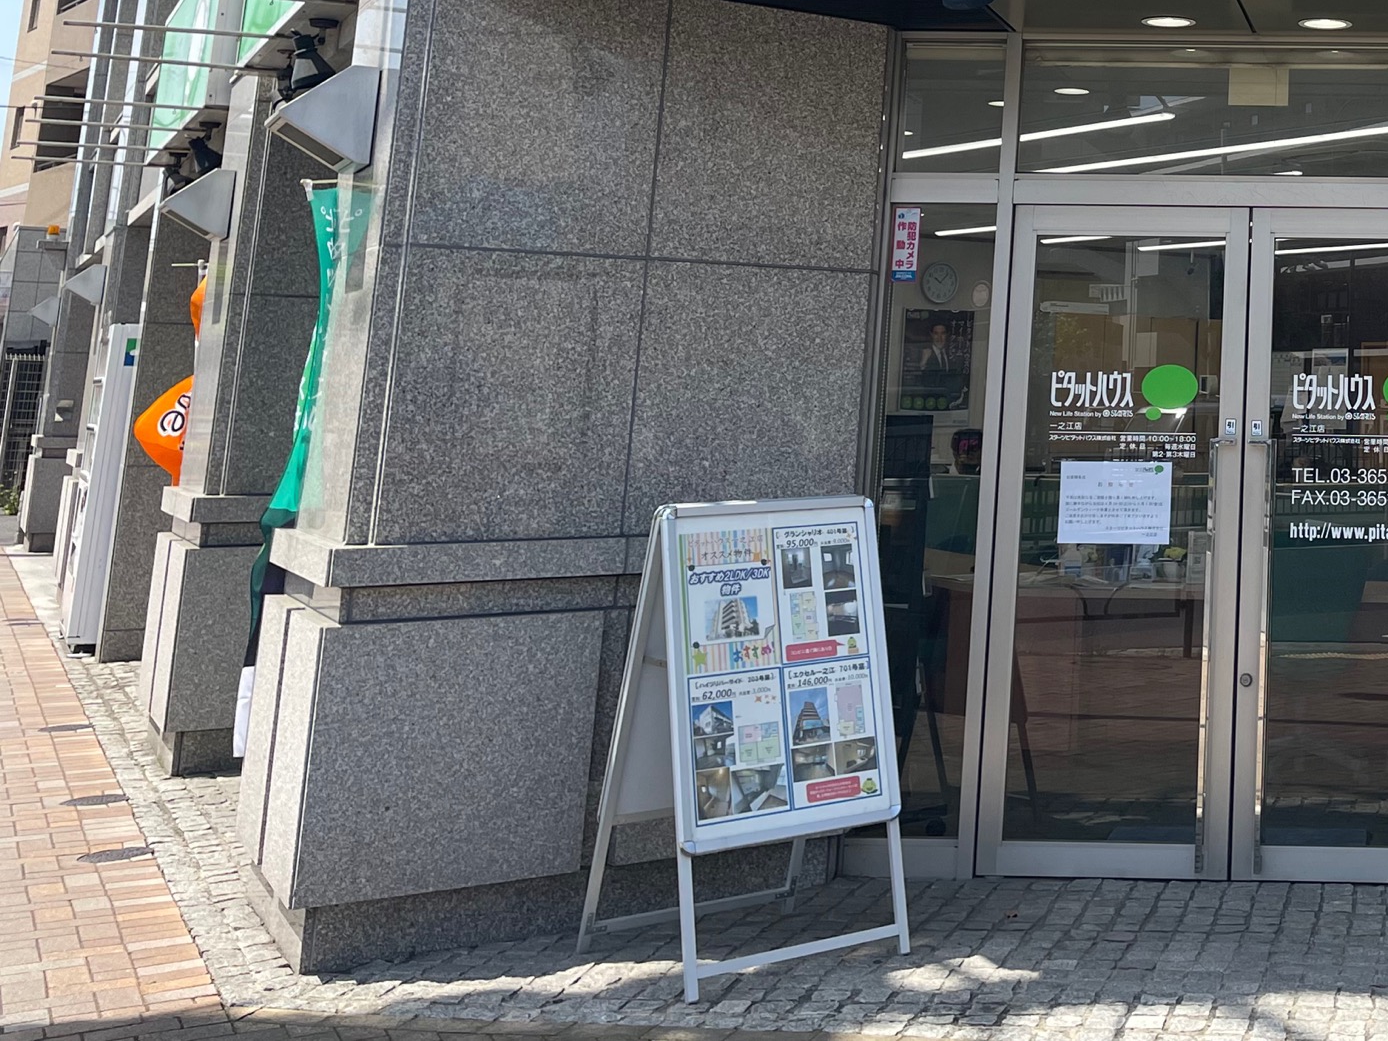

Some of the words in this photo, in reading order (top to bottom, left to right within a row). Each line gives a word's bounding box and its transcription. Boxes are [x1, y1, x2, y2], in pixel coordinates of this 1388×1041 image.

[1050, 370, 1134, 408] ピタットハウス
[1292, 373, 1376, 411] ピタットハウス
[1049, 422, 1083, 430] 一之江店
[1292, 424, 1325, 433] 一之江店
